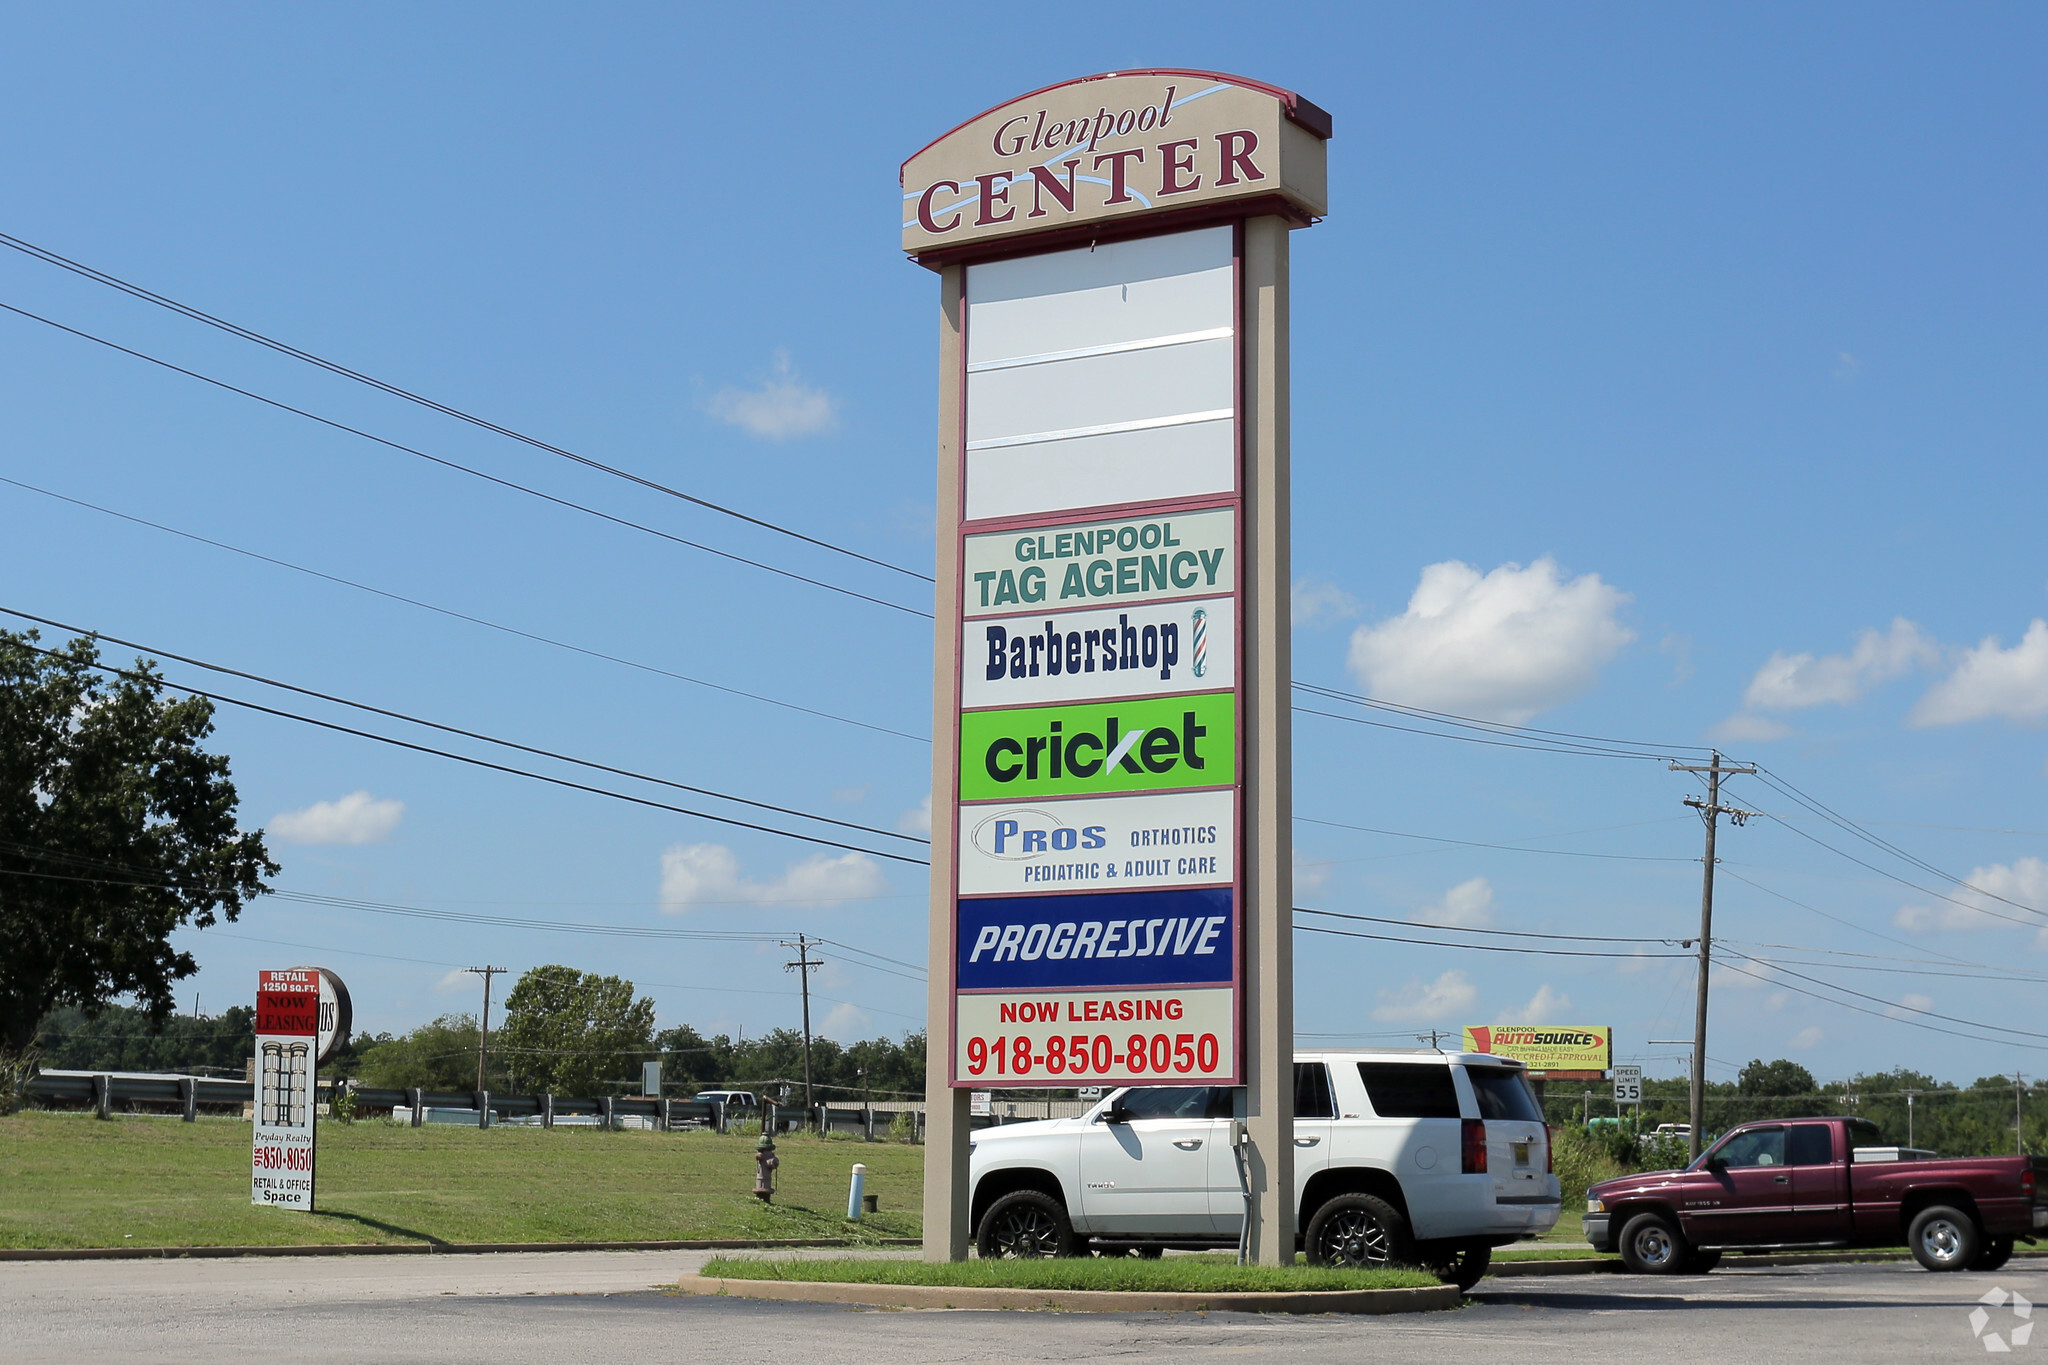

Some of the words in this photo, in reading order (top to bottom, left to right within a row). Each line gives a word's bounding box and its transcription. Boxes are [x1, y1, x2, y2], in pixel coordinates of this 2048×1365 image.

[993, 85, 1175, 156] Glenpool
[917, 130, 1265, 234] CENTER
[1015, 522, 1181, 562] GLENPOOL
[974, 566, 1047, 607] TAG
[1059, 548, 1225, 600] AGENCY
[985, 614, 1179, 681] Barbershop
[985, 711, 1207, 783] cricket
[994, 819, 1107, 854] PROS
[1130, 826, 1217, 848] ORTHOTICS
[1024, 862, 1100, 883] PEDIATRIC
[1106, 862, 1118, 878] &
[1124, 859, 1171, 878] ADULT
[1177, 857, 1217, 875] CARE
[968, 916, 1227, 963] PROGRESSIVE
[263, 982, 288, 992] 1250
[270, 972, 308, 982] RETAIL
[267, 996, 307, 1009] NOW
[1000, 1002, 1060, 1023] NOW
[1068, 999, 1184, 1022] LEASING
[257, 1014, 314, 1031] LEASING
[1493, 1033, 1593, 1045] AUTOSOURCE
[967, 1033, 1219, 1076] 918-850-8050
[1523, 1053, 1555, 1061] CREDIT
[1557, 1053, 1604, 1062] APPROVAL
[1616, 1085, 1640, 1099] 55
[255, 1132, 284, 1144] Peyday
[285, 1133, 312, 1145] Realty
[254, 1147, 263, 1167] 918
[254, 1177, 277, 1189] RETAIL
[279, 1178, 284, 1190] &
[286, 1179, 310, 1191] OFFICE
[263, 1189, 301, 1204] Space
